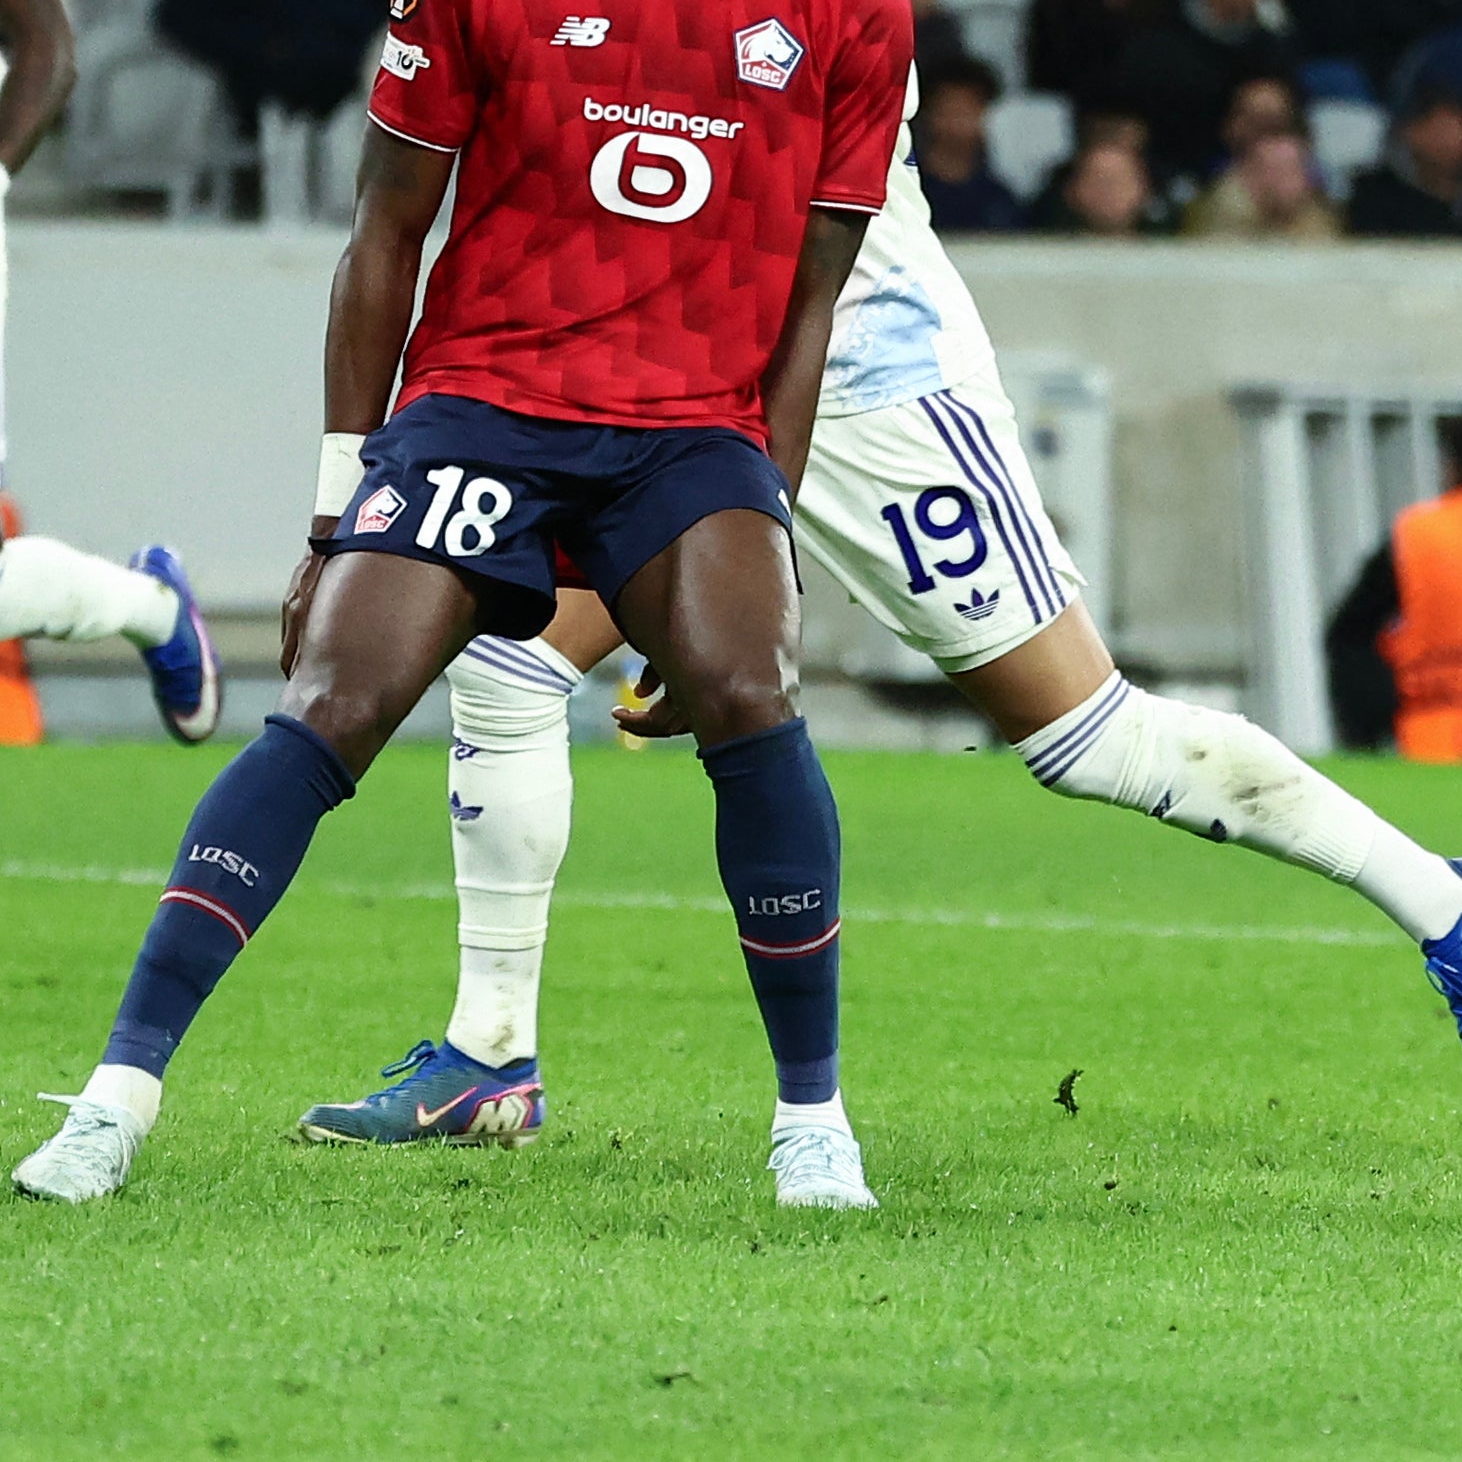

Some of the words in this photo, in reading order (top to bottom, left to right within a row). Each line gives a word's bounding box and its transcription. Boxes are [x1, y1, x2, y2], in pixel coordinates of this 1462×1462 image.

[744, 63, 782, 83] LOSC
[583, 97, 745, 139] boulanger
[415, 464, 513, 557] 18
[880, 485, 988, 595] 19
[188, 843, 260, 888] LOSC
[748, 888, 822, 916] LOSC
